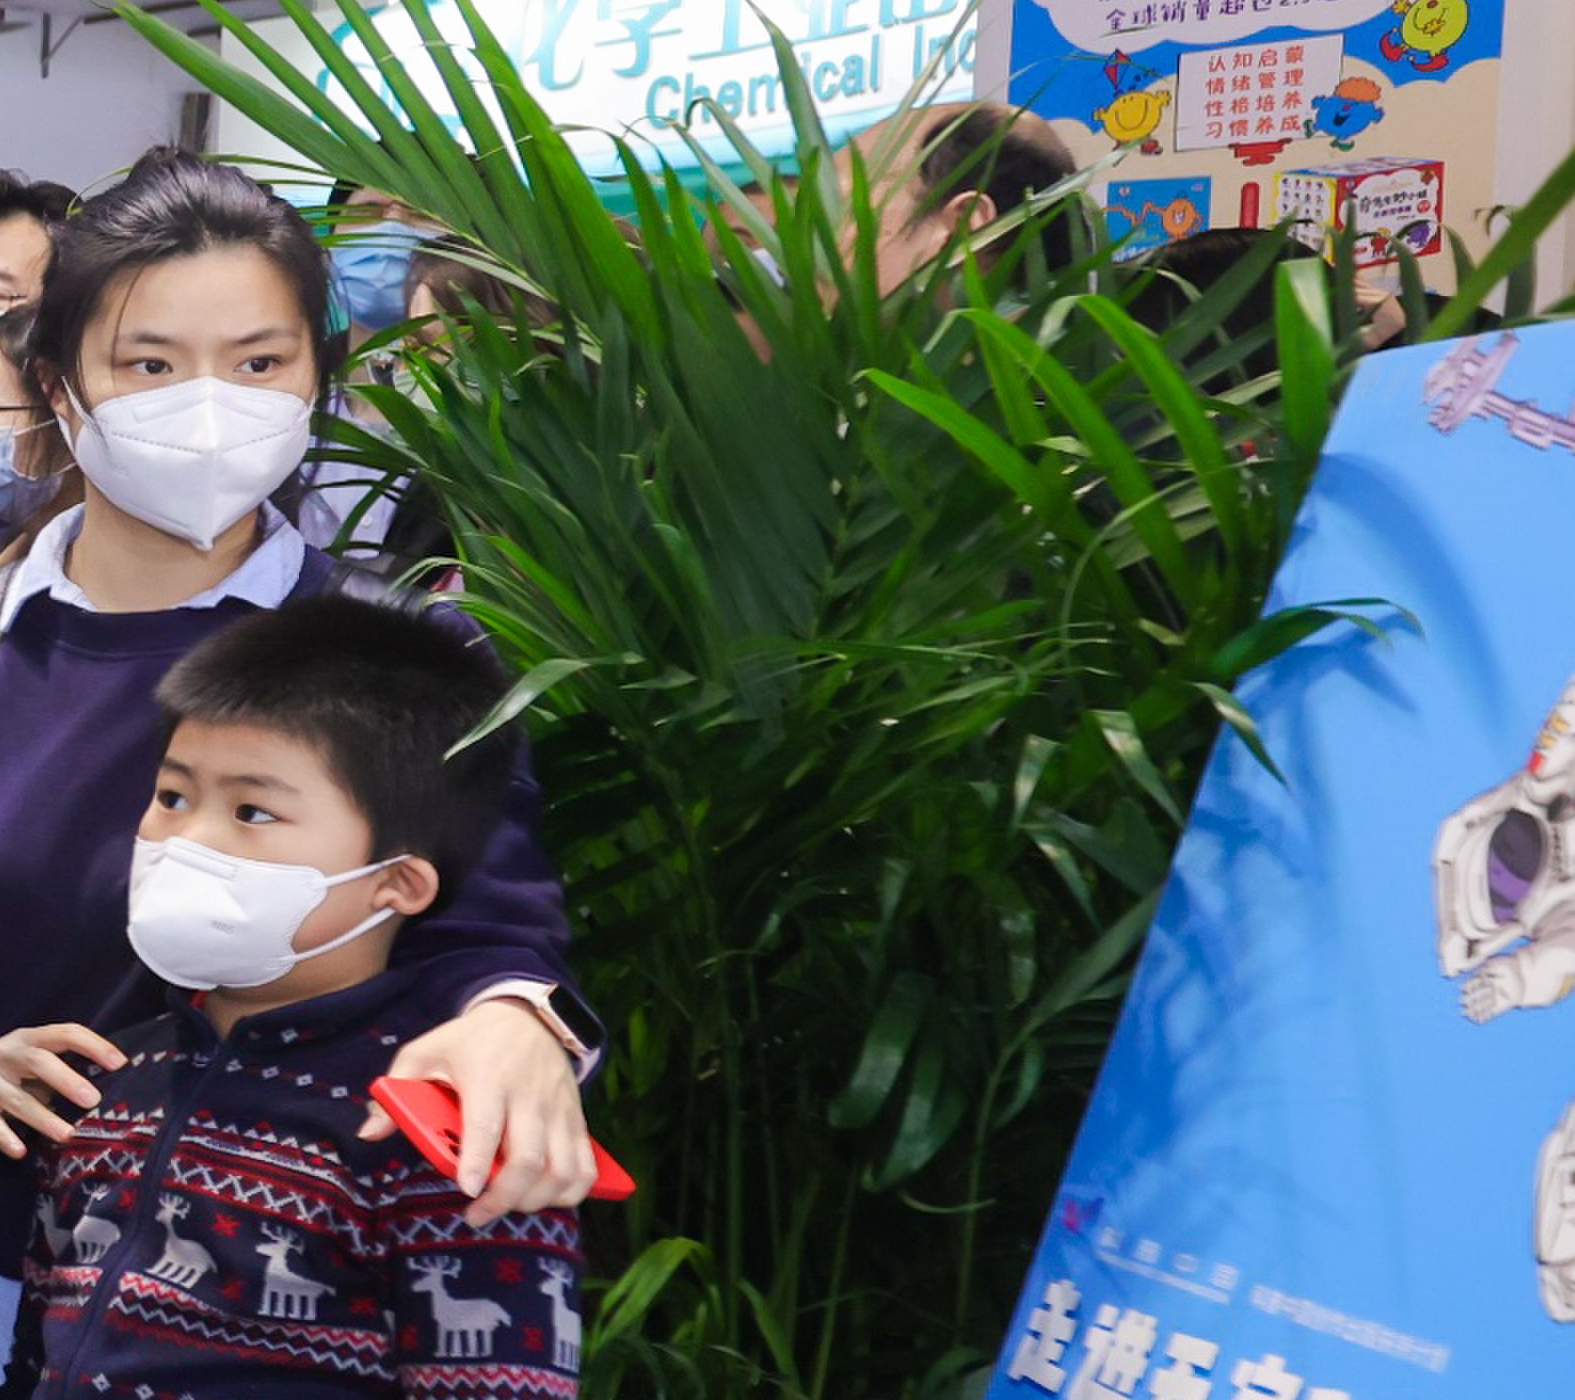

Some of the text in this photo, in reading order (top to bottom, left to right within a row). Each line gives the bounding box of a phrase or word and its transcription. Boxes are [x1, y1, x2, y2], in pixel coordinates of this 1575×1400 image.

[1207, 45, 1305, 73] 认知启蒙
[1205, 69, 1305, 95] 情绪管理
[1205, 91, 1303, 118] 性格培养
[1205, 114, 1302, 139] 习惯养成
